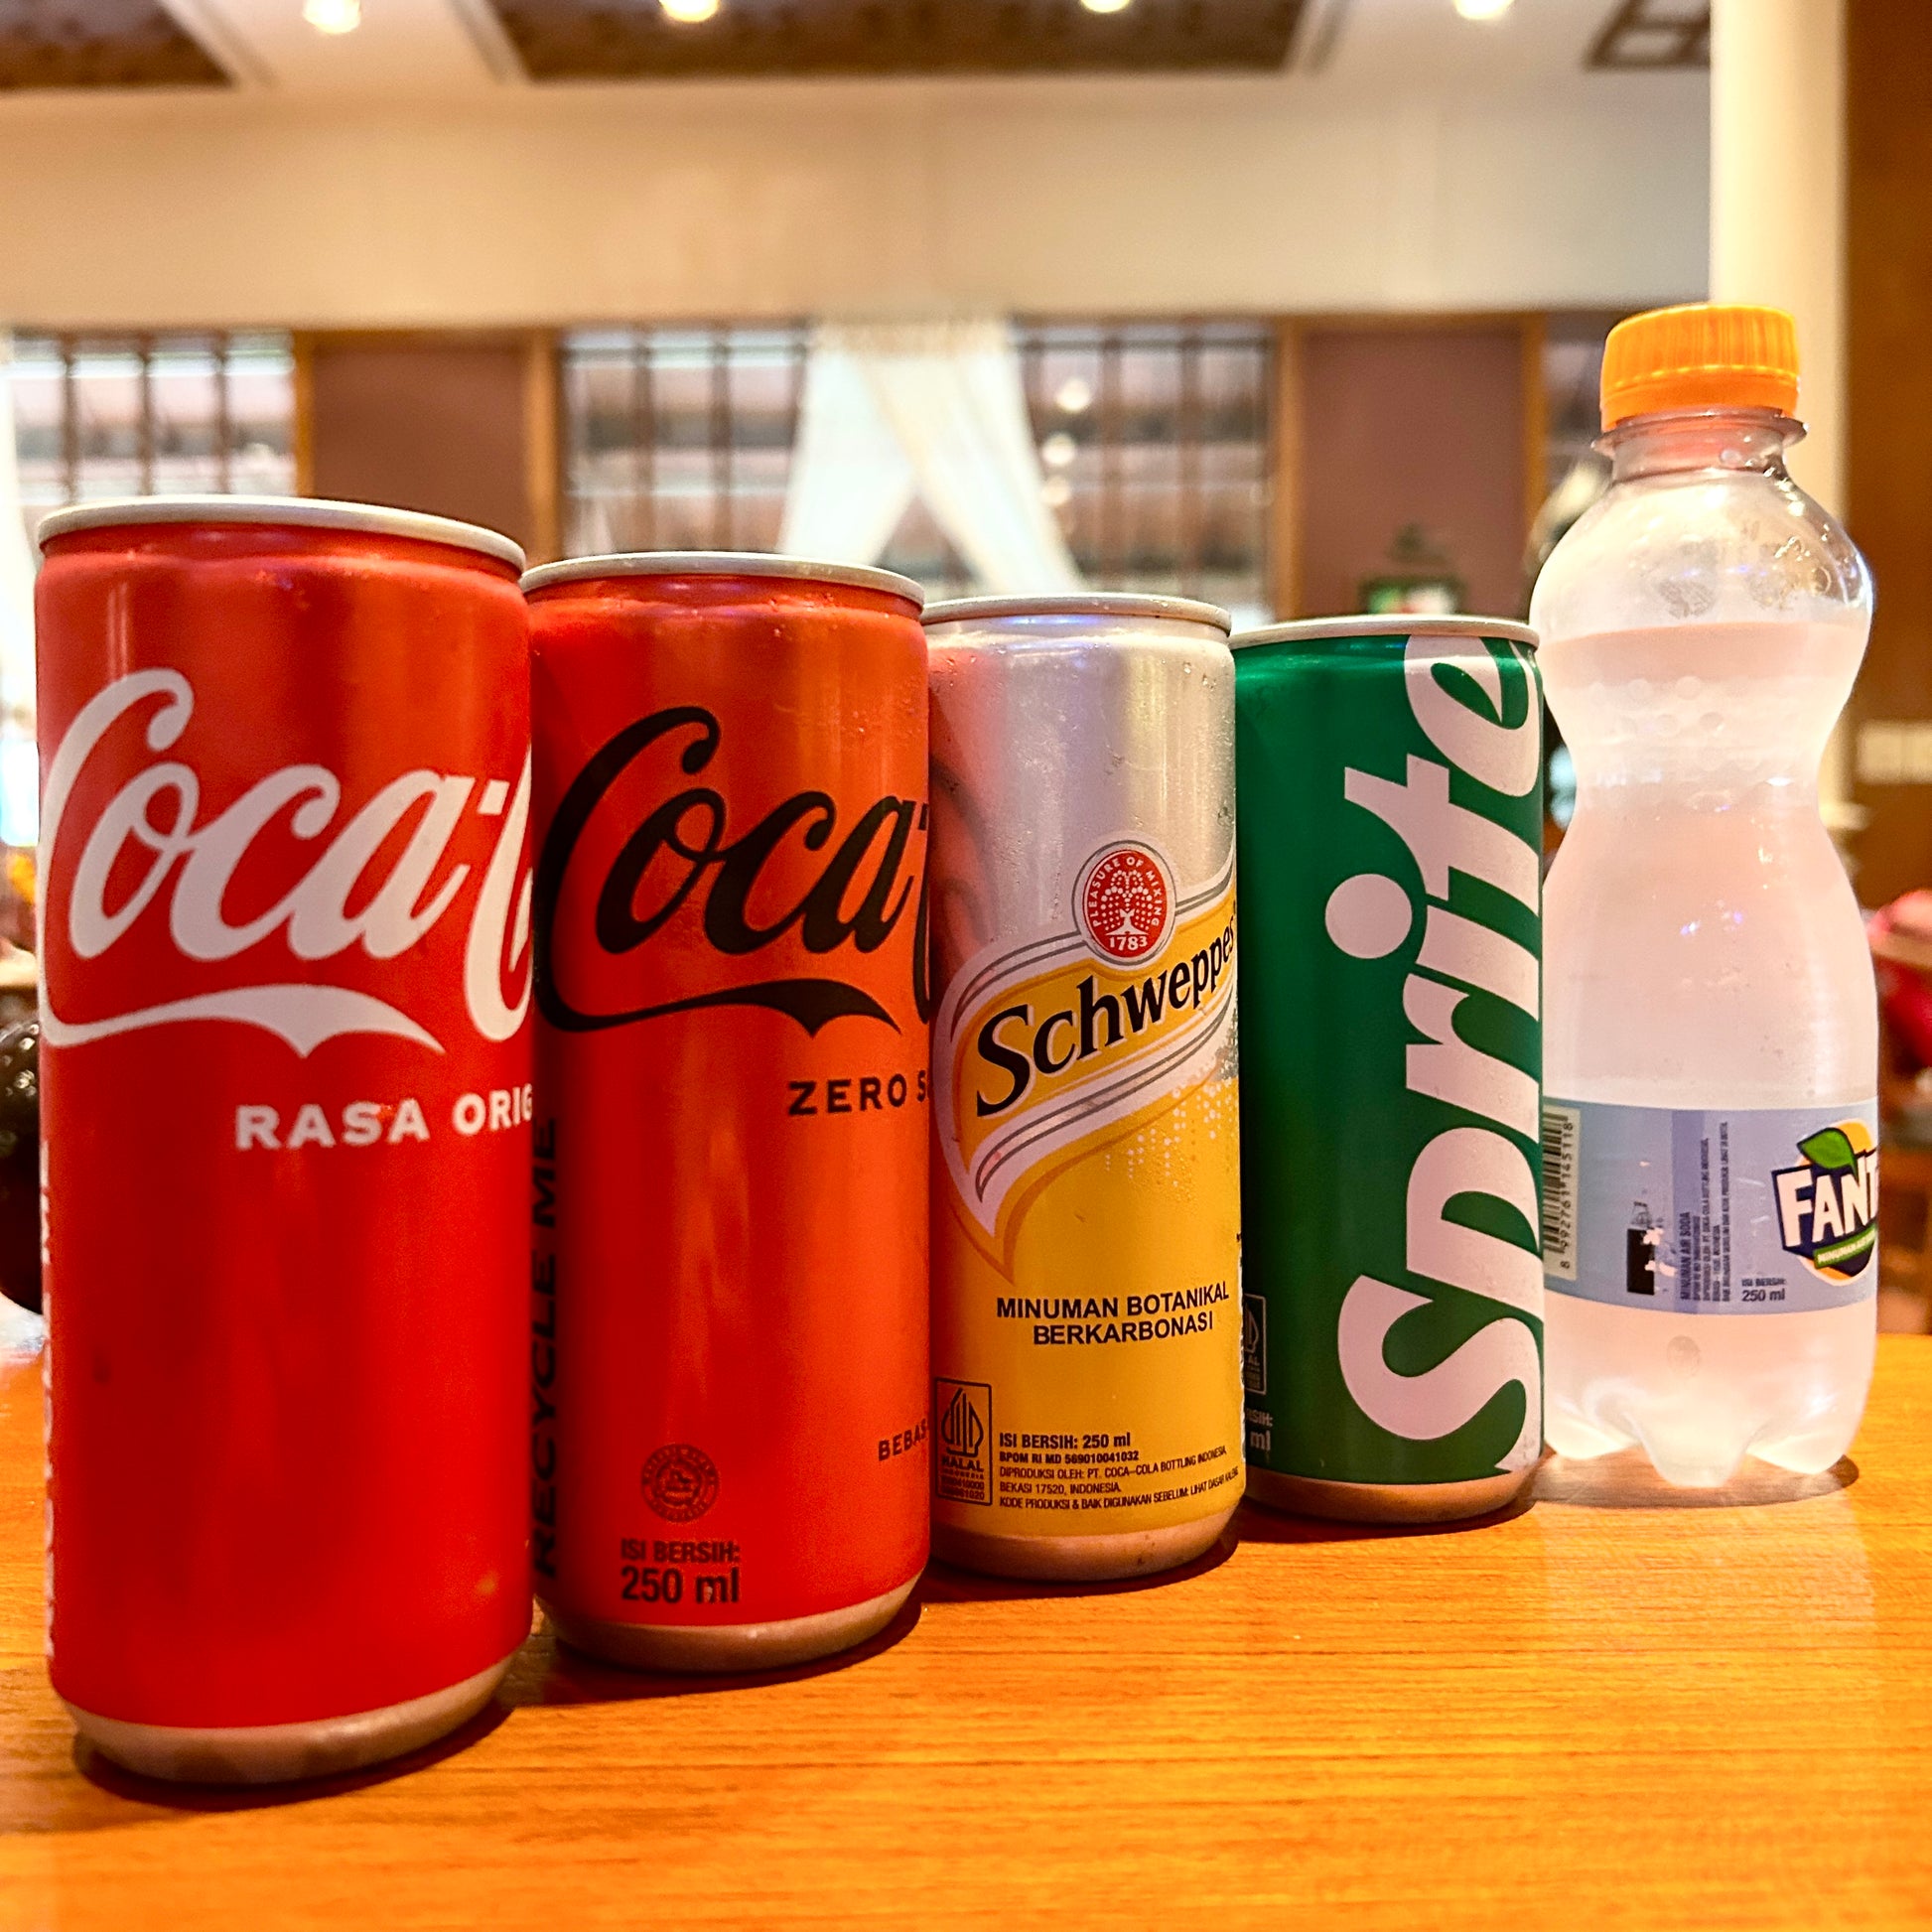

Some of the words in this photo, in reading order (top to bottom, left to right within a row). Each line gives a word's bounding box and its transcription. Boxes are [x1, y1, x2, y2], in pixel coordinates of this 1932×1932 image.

[533, 706, 929, 1038] Coca-
[1088, 858, 1121, 927] PLEASURE
[1126, 856, 1144, 868] OF
[1146, 870, 1164, 926] MIXING
[1109, 935, 1148, 951] 1783
[1323, 634, 1543, 1473] Sprite
[787, 1073, 907, 1117] ZERO
[234, 1097, 430, 1152] RASA
[531, 1117, 557, 1230] ME
[1776, 1149, 1878, 1248] FANT
[1560, 1260, 1571, 1270] 8
[996, 1296, 1119, 1319] MINUMAN
[1126, 1281, 1230, 1316] BOTANIKAL
[1741, 1289, 1766, 1302] 250
[1769, 1288, 1785, 1301] ml
[1033, 1310, 1214, 1345] BERKARBONASI
[531, 1250, 557, 1581] RECYCLE
[999, 1432, 1018, 1449] ISI
[1022, 1433, 1078, 1449] BERSIH:
[1082, 1434, 1110, 1449] 250
[1113, 1431, 1131, 1448] ml
[999, 1450, 1029, 1463] BPOM
[1032, 1452, 1042, 1464] RI
[1045, 1453, 1062, 1464] MD
[941, 1454, 984, 1472] HALAL
[999, 1465, 1054, 1479] DIPRODUKSI
[1161, 1455, 1196, 1472] BOTTLING
[999, 1480, 1033, 1494] BEKASI
[1035, 1483, 1067, 1496] 17520,
[999, 1496, 1024, 1509] KODE
[1026, 1497, 1070, 1510] PRODUKSI
[1072, 1499, 1079, 1510] &
[1081, 1498, 1102, 1510] BAIK
[1103, 1493, 1152, 1508] DIGUNAKAN
[620, 1537, 647, 1562] ISI
[652, 1539, 741, 1563] BERSIH:
[620, 1565, 684, 1602] 250
[694, 1564, 741, 1603] ml
